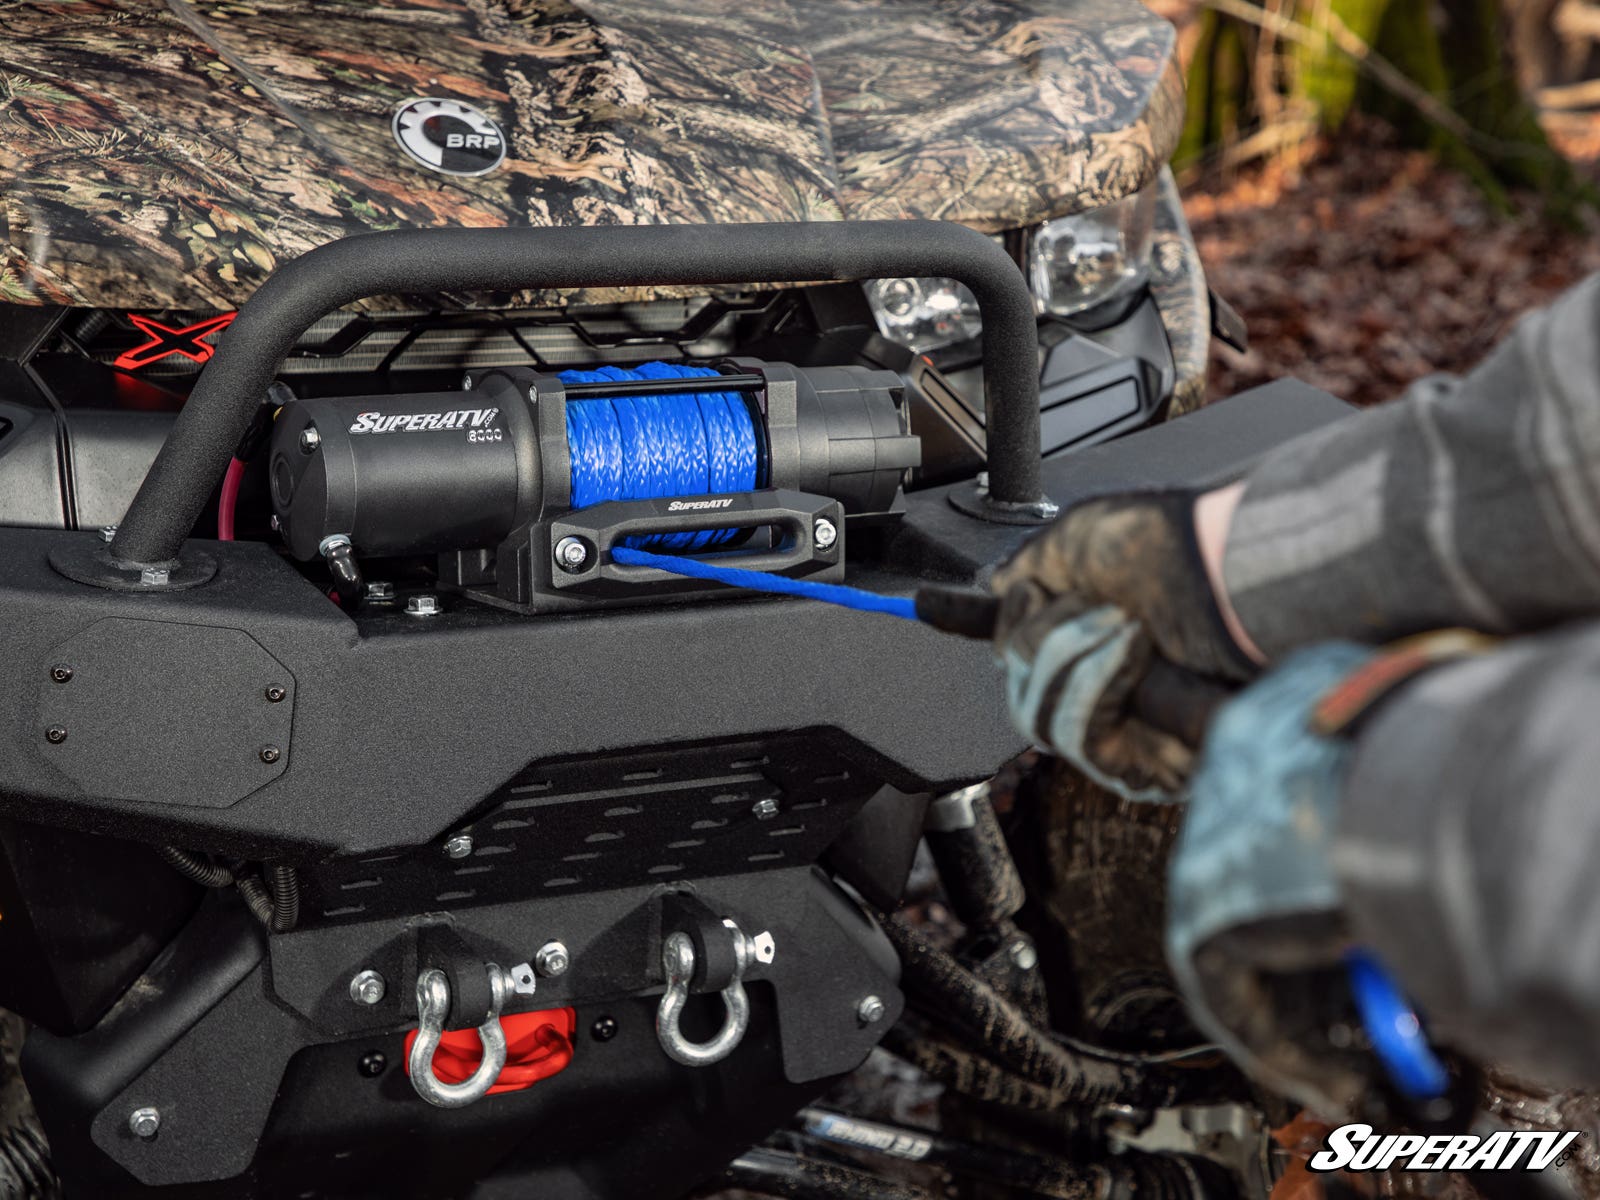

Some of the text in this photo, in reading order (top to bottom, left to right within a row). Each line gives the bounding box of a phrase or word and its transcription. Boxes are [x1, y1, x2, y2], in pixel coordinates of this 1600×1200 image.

[446, 133, 500, 149] BRP
[350, 408, 492, 433] SUPERATV
[668, 498, 733, 511] SUPERATV
